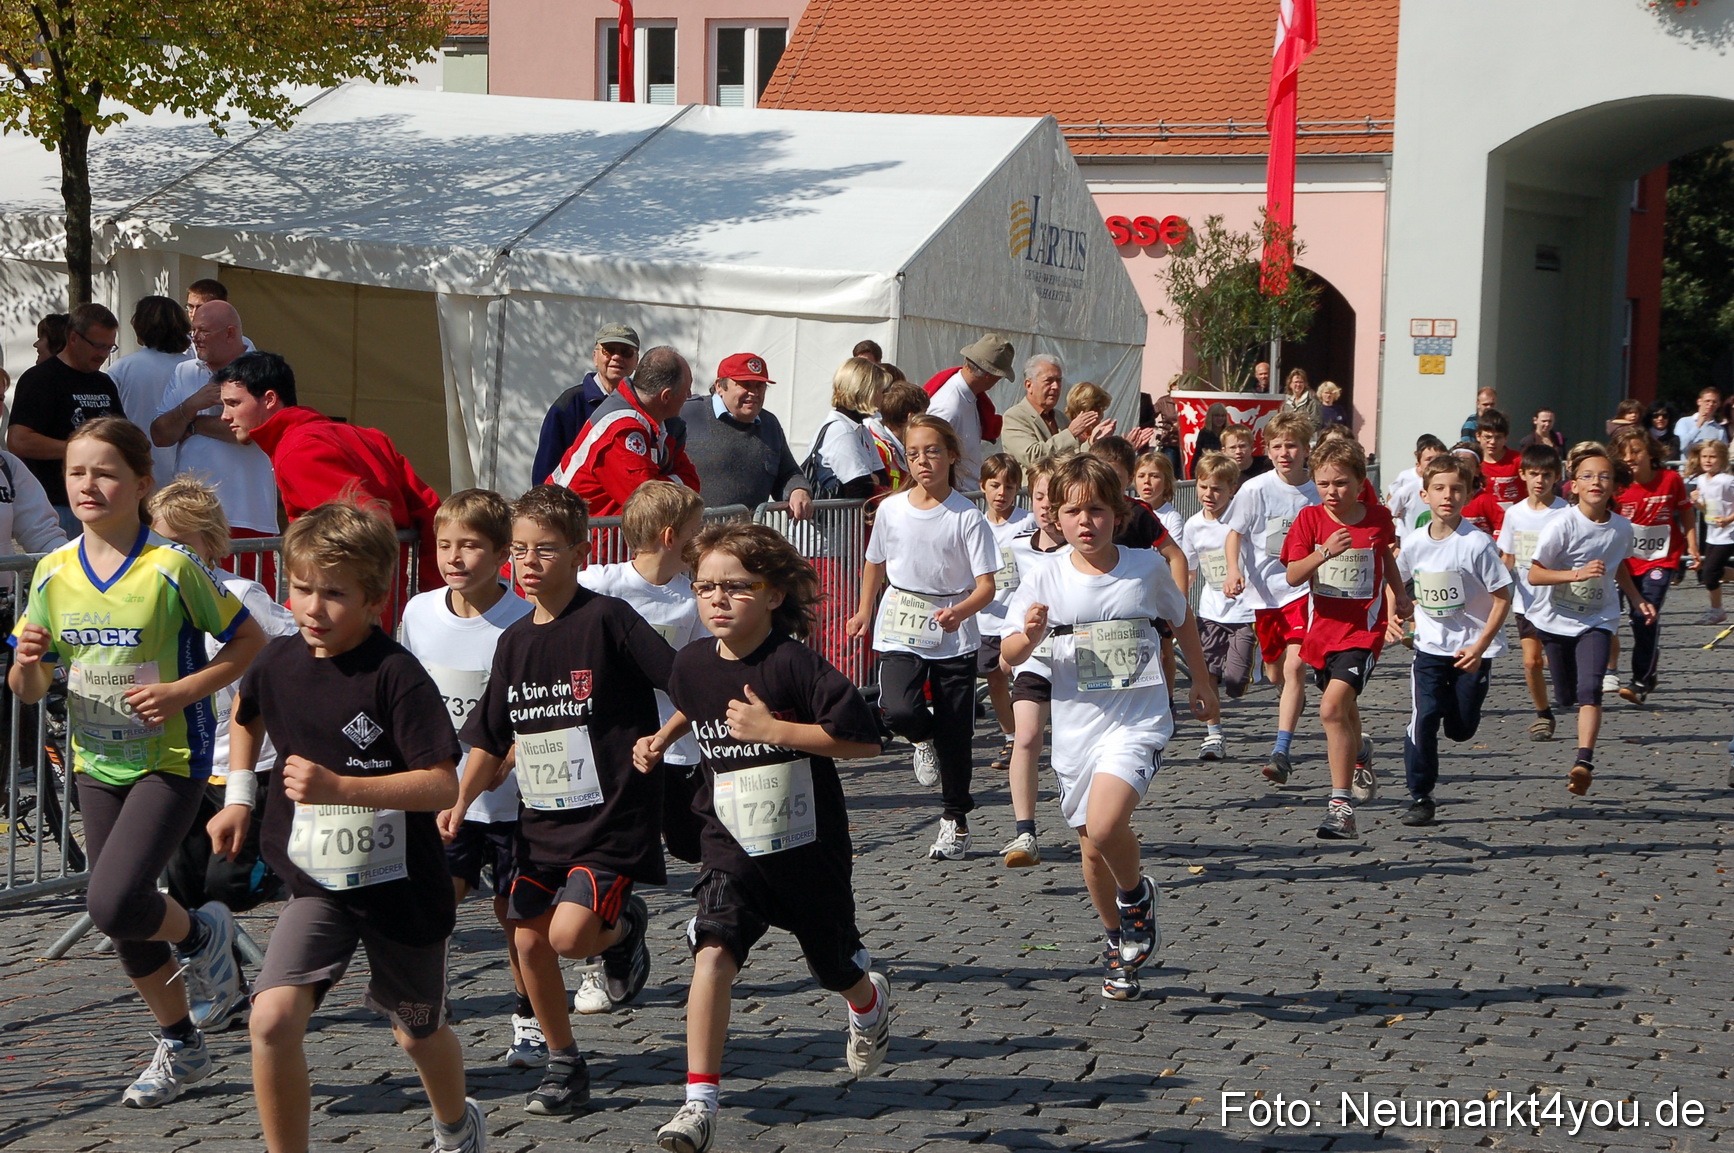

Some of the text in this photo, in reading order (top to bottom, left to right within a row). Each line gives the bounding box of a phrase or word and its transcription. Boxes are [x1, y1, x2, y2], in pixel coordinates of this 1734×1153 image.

[1105, 215, 1189, 246] sse
[1281, 519, 1292, 528] Flo
[1331, 553, 1369, 562] bastian
[1329, 566, 1368, 582] 7121
[900, 595, 925, 609] Melina
[1423, 587, 1459, 602] 7303
[61, 611, 111, 627] TEAM
[899, 611, 938, 632] 7176
[61, 628, 143, 647] BOCK
[1096, 626, 1146, 642] Sebastian
[84, 669, 136, 686] Marlene
[522, 681, 549, 700] bin
[551, 679, 572, 698] ein
[89, 693, 133, 716] 716
[509, 697, 593, 723] eumarkter!
[691, 718, 734, 740] Ich bi
[521, 738, 564, 756] Nicolas
[346, 756, 392, 769] Jonathan
[529, 758, 586, 785] 7247
[739, 774, 779, 793] Niklas
[743, 792, 808, 827] 7245
[320, 823, 396, 856] 7083
[781, 829, 815, 845] PFLEIDERER
[360, 863, 404, 880] PFLEIDERER
